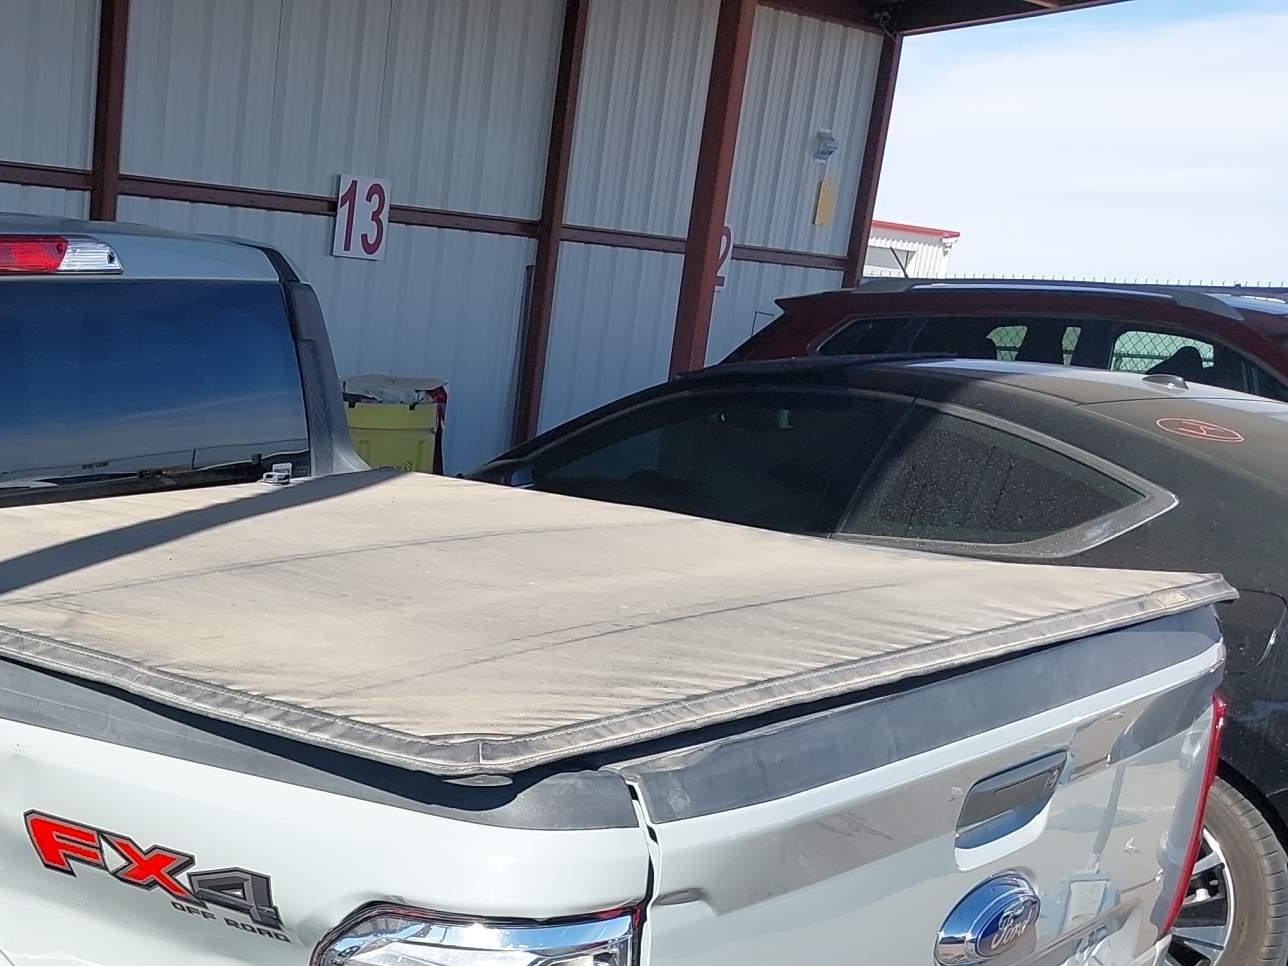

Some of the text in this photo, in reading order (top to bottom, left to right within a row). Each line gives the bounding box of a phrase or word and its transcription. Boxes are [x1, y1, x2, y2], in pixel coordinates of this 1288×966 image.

[339, 180, 386, 255] 13
[23, 808, 285, 931] FX4
[170, 900, 292, 944] OFF ROAD
[989, 897, 1034, 951] Ford
